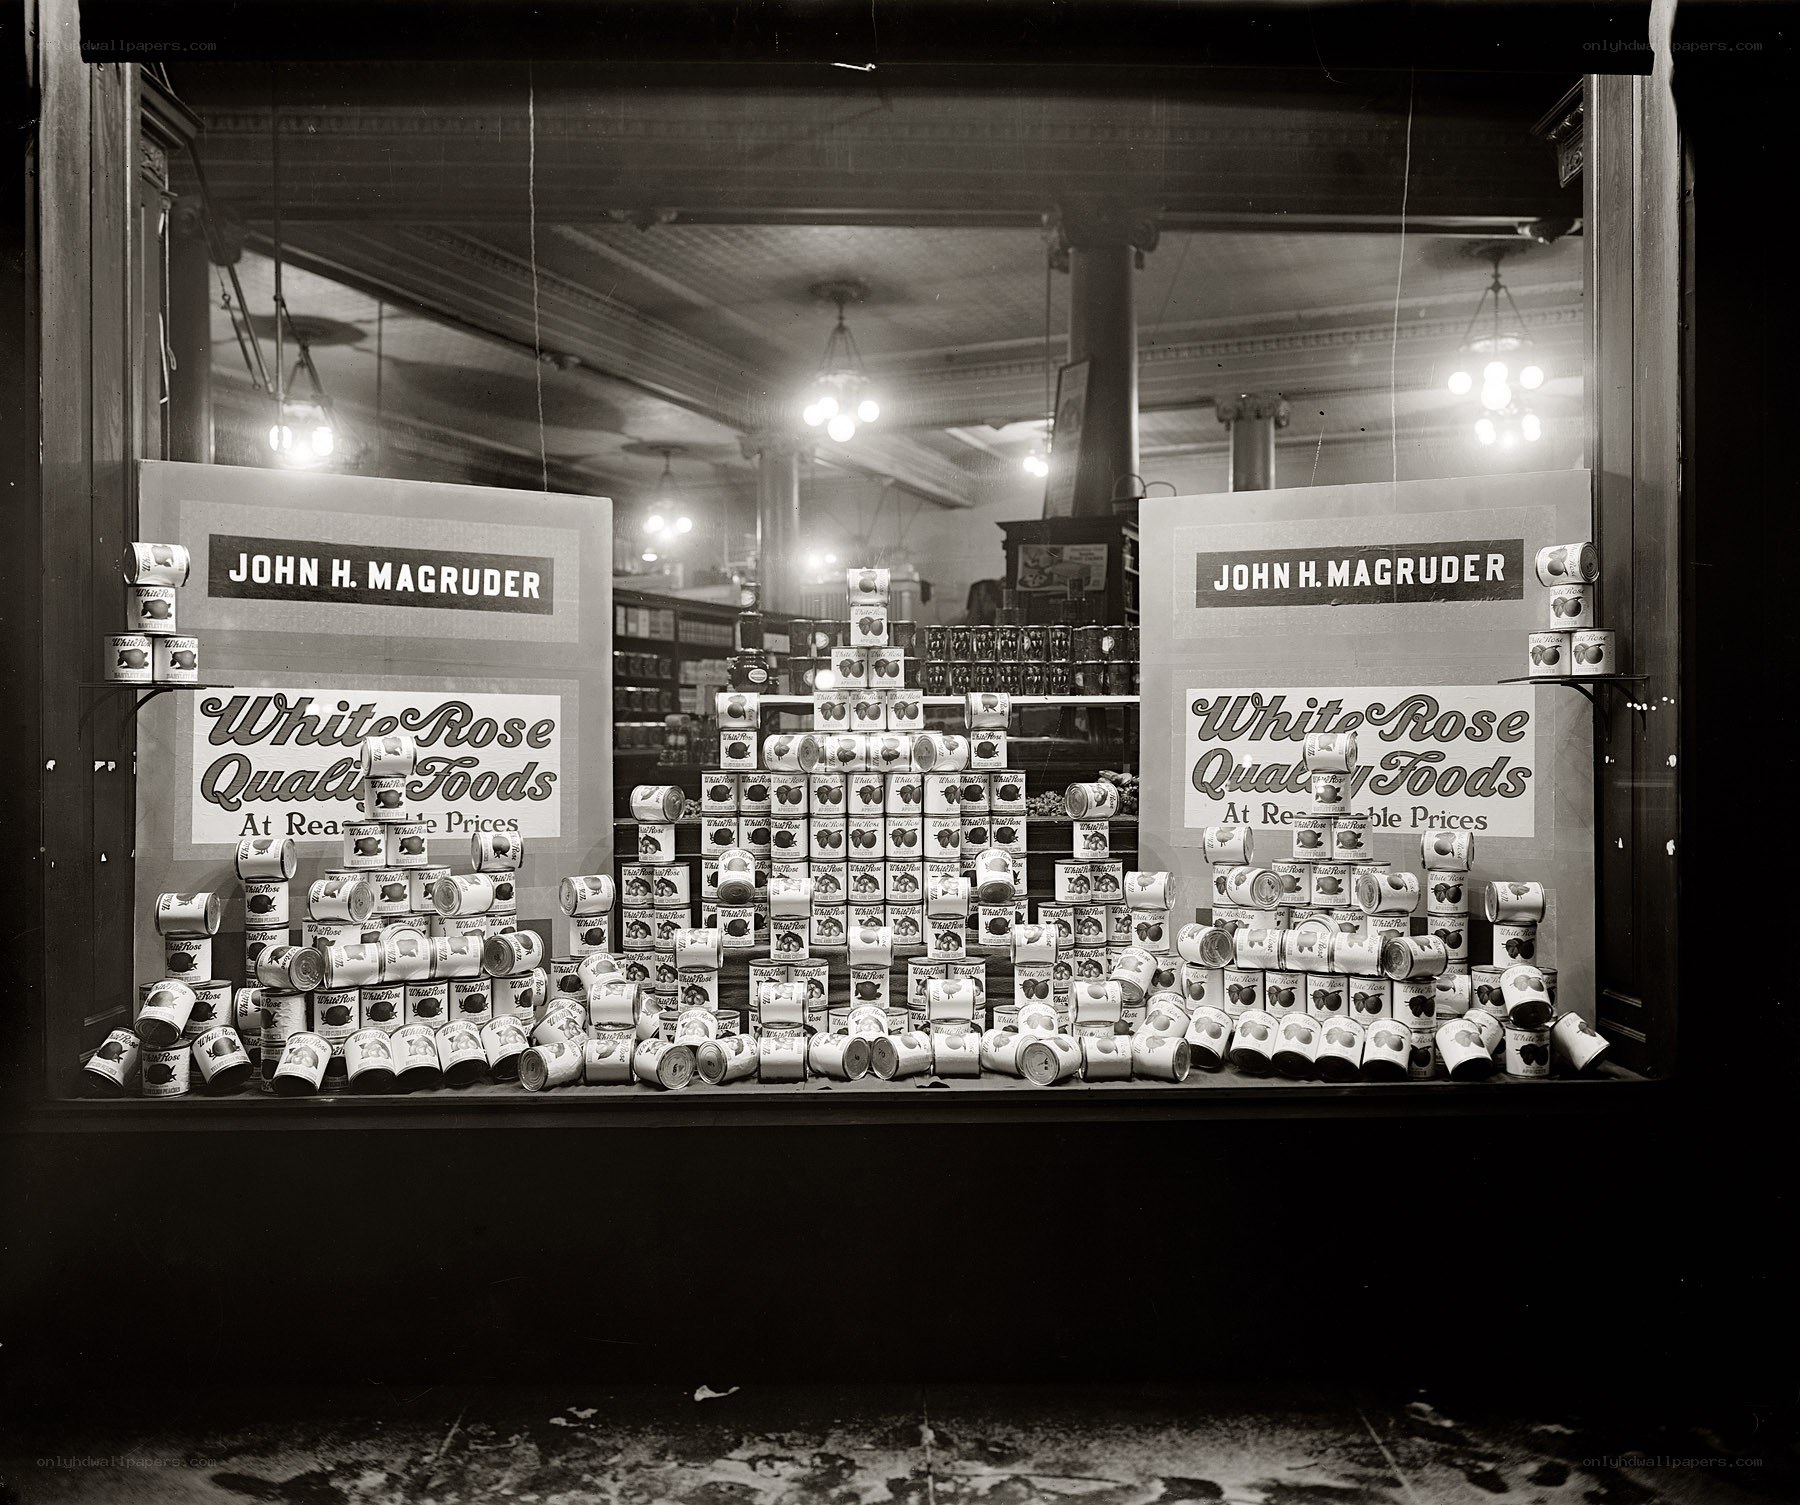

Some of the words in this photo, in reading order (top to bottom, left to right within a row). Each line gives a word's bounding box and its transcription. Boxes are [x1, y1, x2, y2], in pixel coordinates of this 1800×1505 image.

[229, 552, 319, 587] JOHN
[332, 559, 356, 588] H.
[368, 561, 540, 599] MAGRUDER
[1214, 562, 1290, 591] JOHN
[1299, 561, 1322, 588] H.
[1328, 553, 1505, 587] MAGRUDER
[136, 589, 160, 597] White
[112, 638, 138, 647] White
[201, 693, 399, 748] White
[400, 700, 556, 749] Rose
[1192, 692, 1365, 742] White
[1365, 694, 1530, 743] Rose
[1369, 750, 1532, 798] Foods
[406, 756, 557, 803] Foods
[1329, 775, 1345, 783] Rose
[371, 780, 393, 788] White
[1222, 802, 1249, 823] At
[1410, 807, 1488, 830] Prices
[239, 812, 272, 836] At
[446, 810, 519, 833] Prices
[784, 822, 800, 830] Rose
[1007, 818, 1021, 826] Rose
[1310, 821, 1327, 829] Rose
[349, 828, 373, 836] White
[394, 827, 416, 835] White
[649, 826, 664, 834] Rose
[624, 868, 642, 876] White
[812, 864, 829, 872] White
[850, 864, 867, 872] White
[890, 864, 906, 872] White
[1290, 865, 1305, 874] Rose
[1330, 867, 1346, 875] Rose
[375, 874, 397, 882] White
[261, 884, 280, 893] Rose
[624, 911, 642, 919] White
[721, 909, 736, 917] White
[1042, 909, 1061, 917] White
[1092, 908, 1104, 916] Rose
[773, 922, 791, 930] White
[260, 932, 277, 941] Rose
[182, 942, 202, 950] Rose
[753, 968, 773, 977] White
[912, 966, 930, 974] White
[954, 966, 971, 974] White
[1018, 969, 1035, 977] White
[695, 974, 712, 982] Rose
[868, 972, 885, 980] Rose
[429, 987, 446, 995] Rose
[454, 985, 474, 993] White
[473, 983, 490, 991] Rose
[317, 996, 341, 1004] White
[340, 995, 356, 1003] Rose
[362, 992, 383, 1000] White
[118, 1033, 138, 1048] Rose
[160, 1052, 180, 1061] Rose
